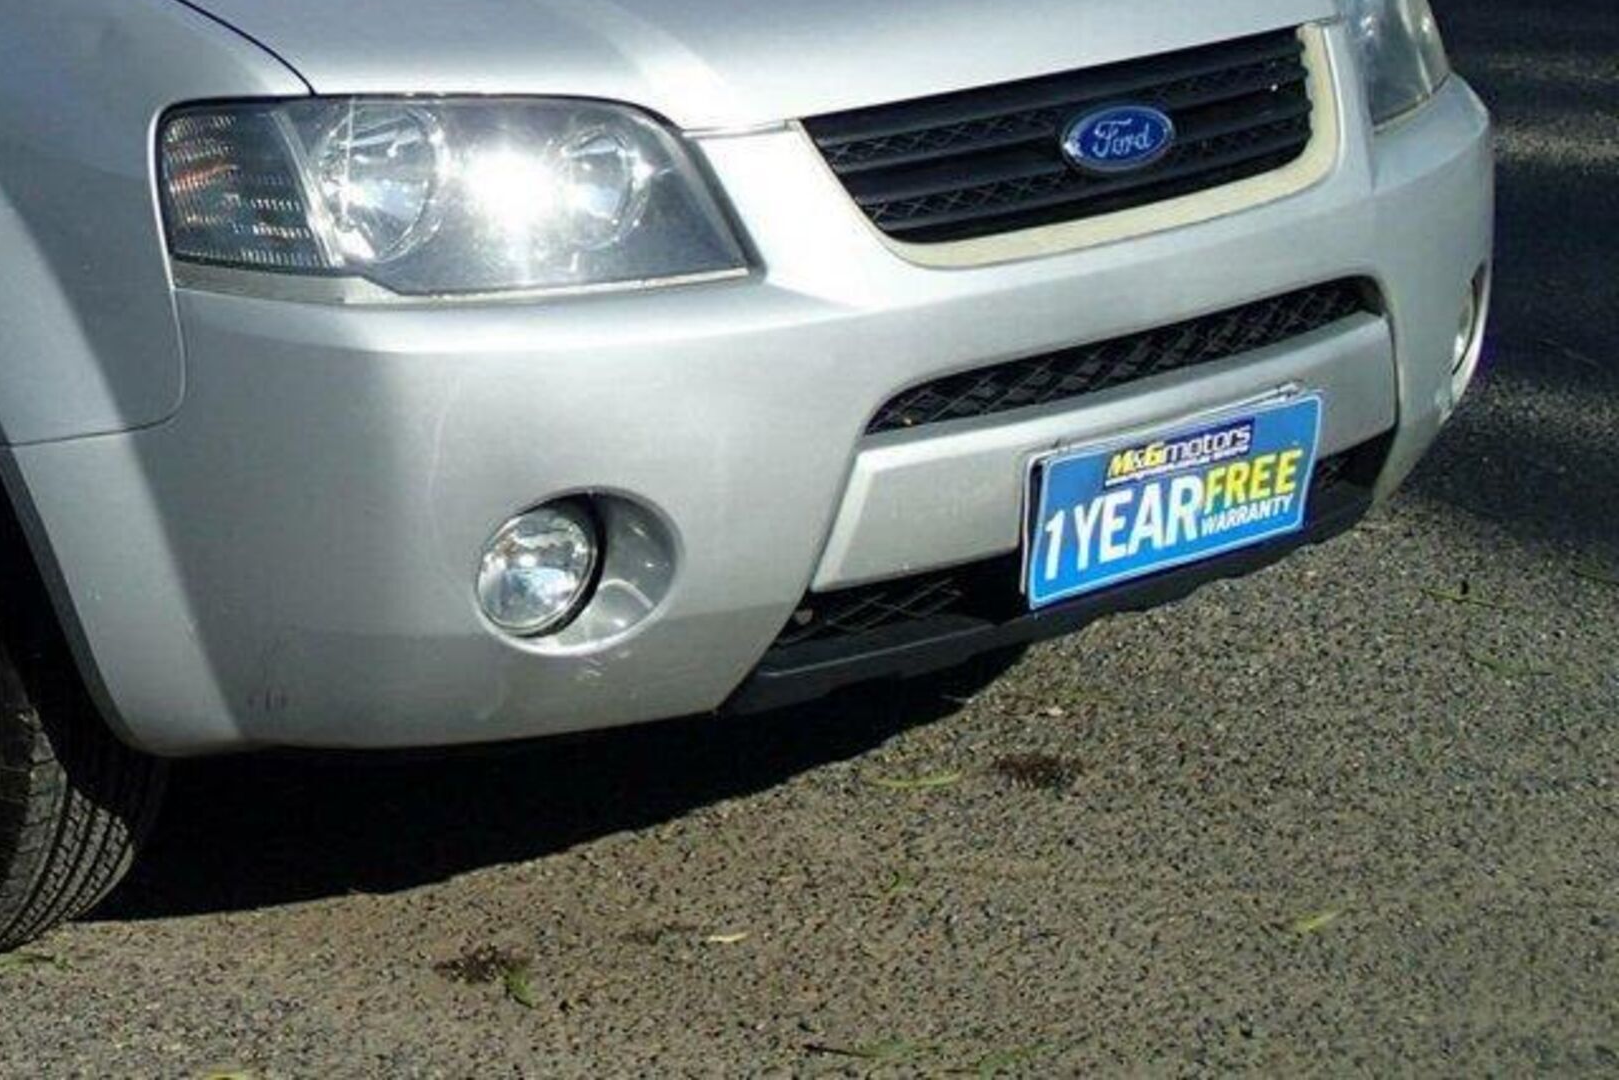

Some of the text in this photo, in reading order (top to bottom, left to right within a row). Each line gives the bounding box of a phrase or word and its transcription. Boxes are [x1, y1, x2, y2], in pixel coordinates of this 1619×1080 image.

[1093, 118, 1153, 158] Ford
[1044, 509, 1065, 581] 1
[1073, 475, 1204, 571] YEAR
[1204, 448, 1303, 514] FREE
[1201, 494, 1294, 537] WARRANTY
